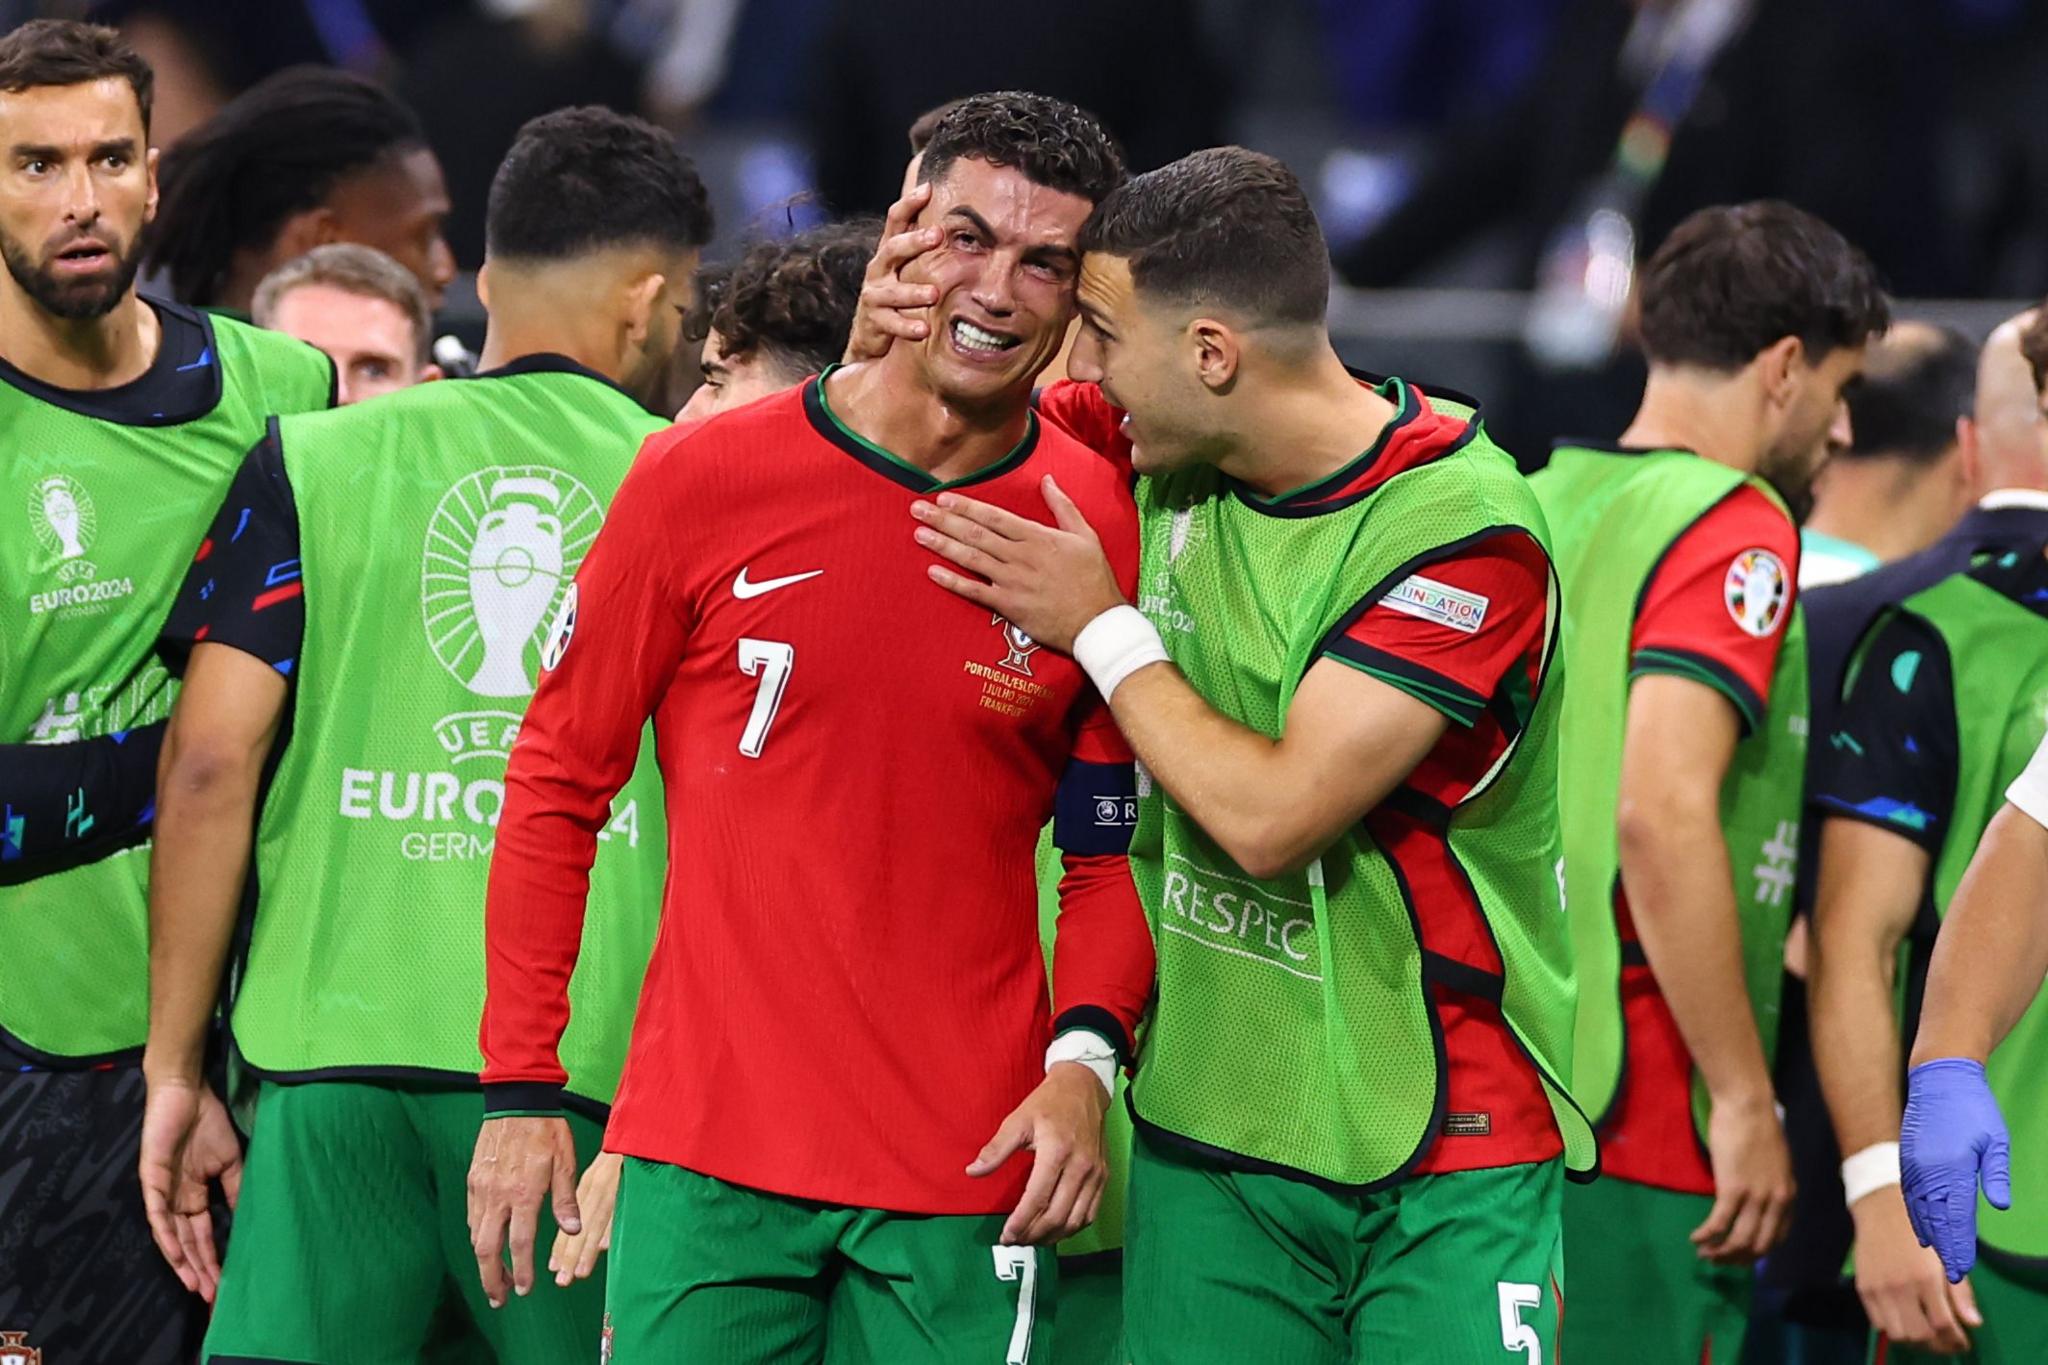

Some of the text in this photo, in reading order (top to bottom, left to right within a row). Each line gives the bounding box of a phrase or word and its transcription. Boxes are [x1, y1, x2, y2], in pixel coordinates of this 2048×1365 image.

[30, 577, 133, 613] EURO2024
[738, 637, 794, 759] 7
[1163, 870, 1314, 961] RESPEC
[992, 1244, 1038, 1365] 7
[1497, 1281, 1541, 1365] 5
